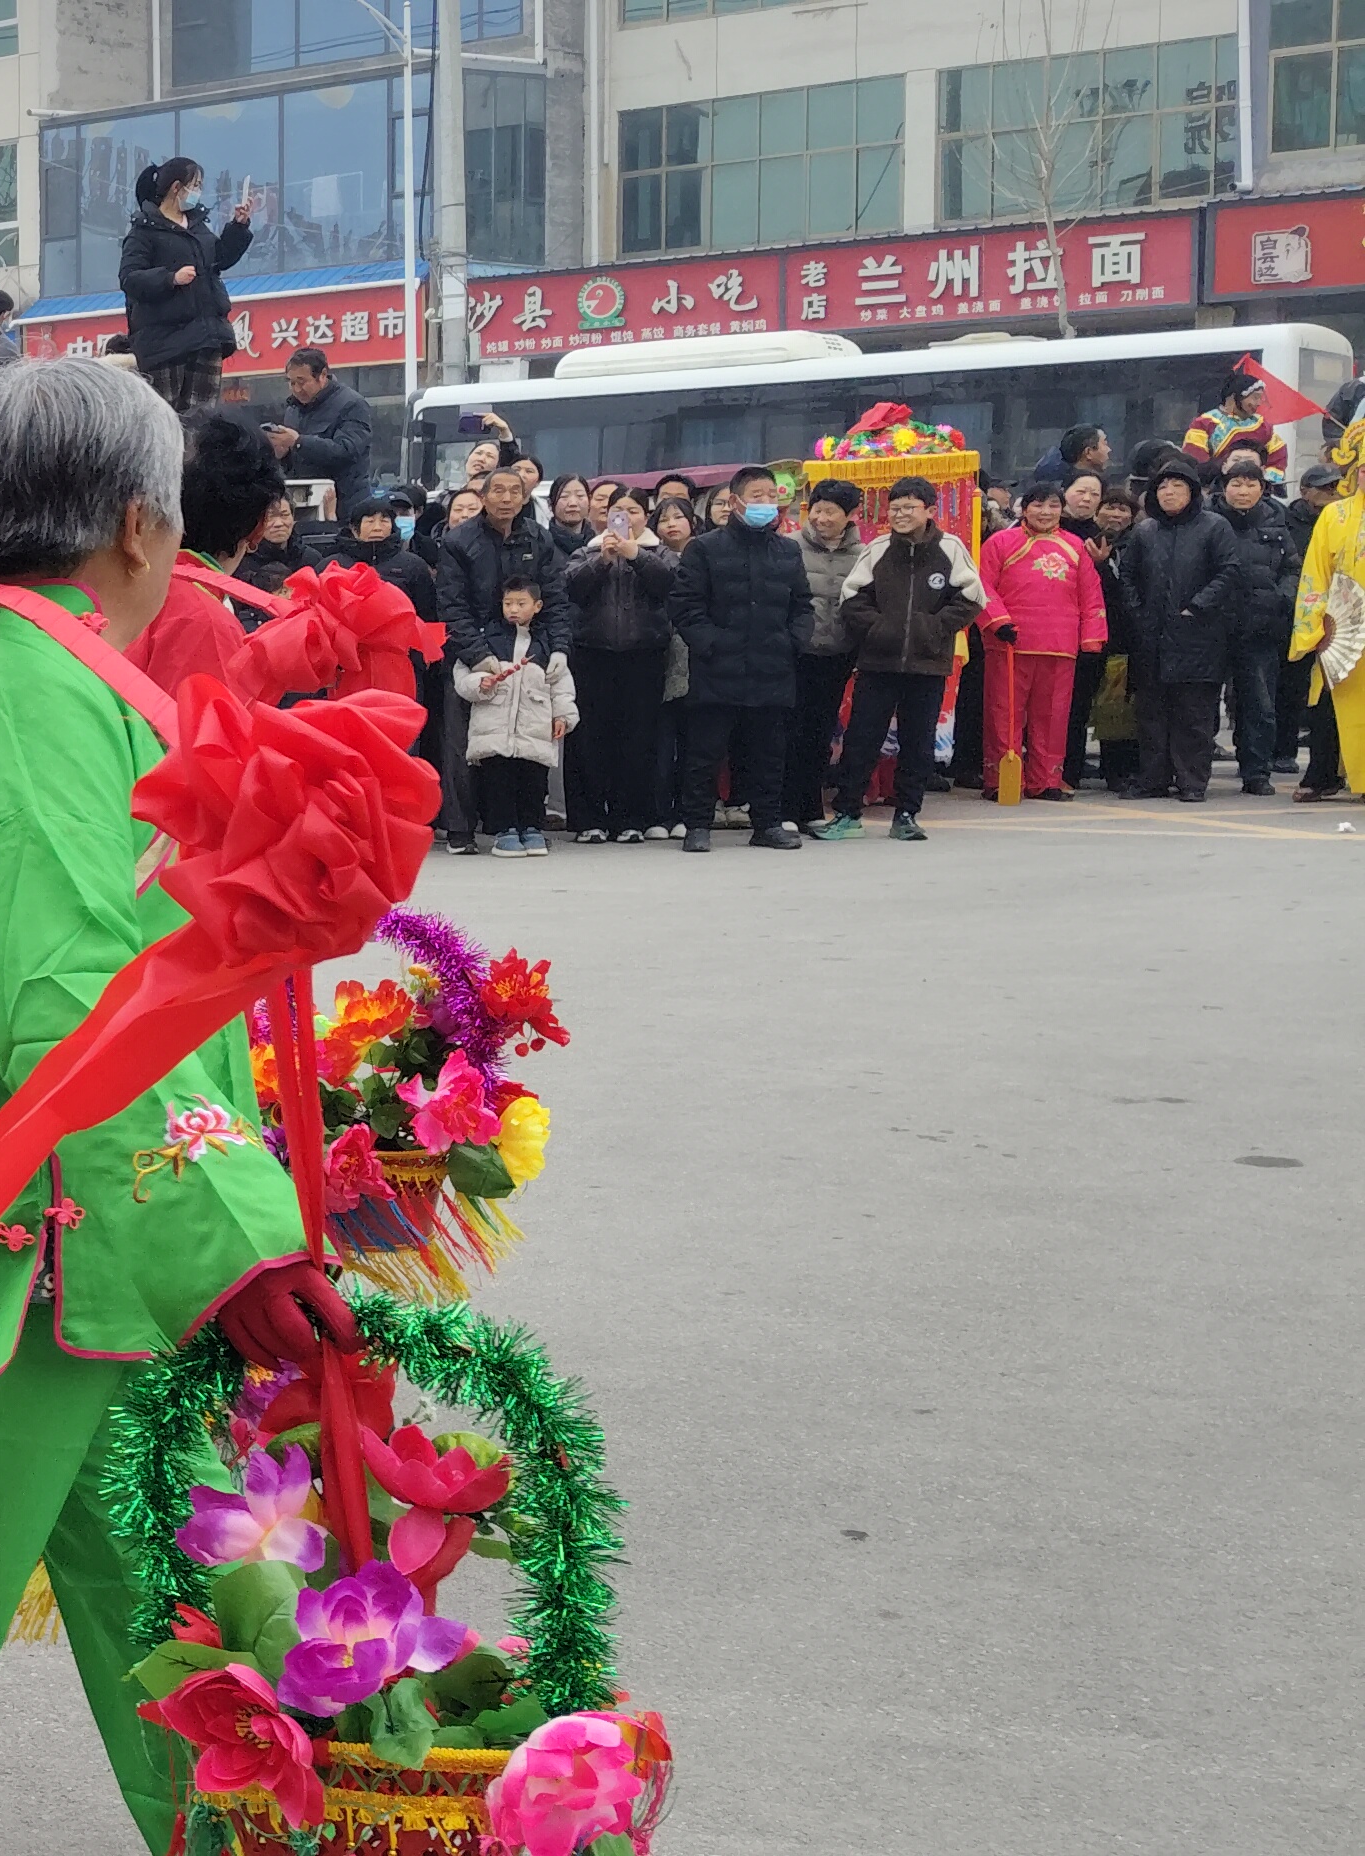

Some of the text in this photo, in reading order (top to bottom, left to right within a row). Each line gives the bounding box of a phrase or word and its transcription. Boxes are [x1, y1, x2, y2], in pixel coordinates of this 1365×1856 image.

[853, 231, 1146, 307] 兰州拉面
[1257, 236, 1279, 278] 白云边
[651, 269, 759, 315] 小吃
[800, 260, 828, 321] 老店
[899, 304, 945, 319] 大盘鸡
[1078, 291, 1109, 306] 拉面
[1119, 286, 1165, 303] 刀削面
[271, 308, 406, 349] 兴达超市
[540, 336, 563, 350] 炒面
[568, 332, 603, 347] 炒河粉
[673, 322, 722, 338] 商务套餐
